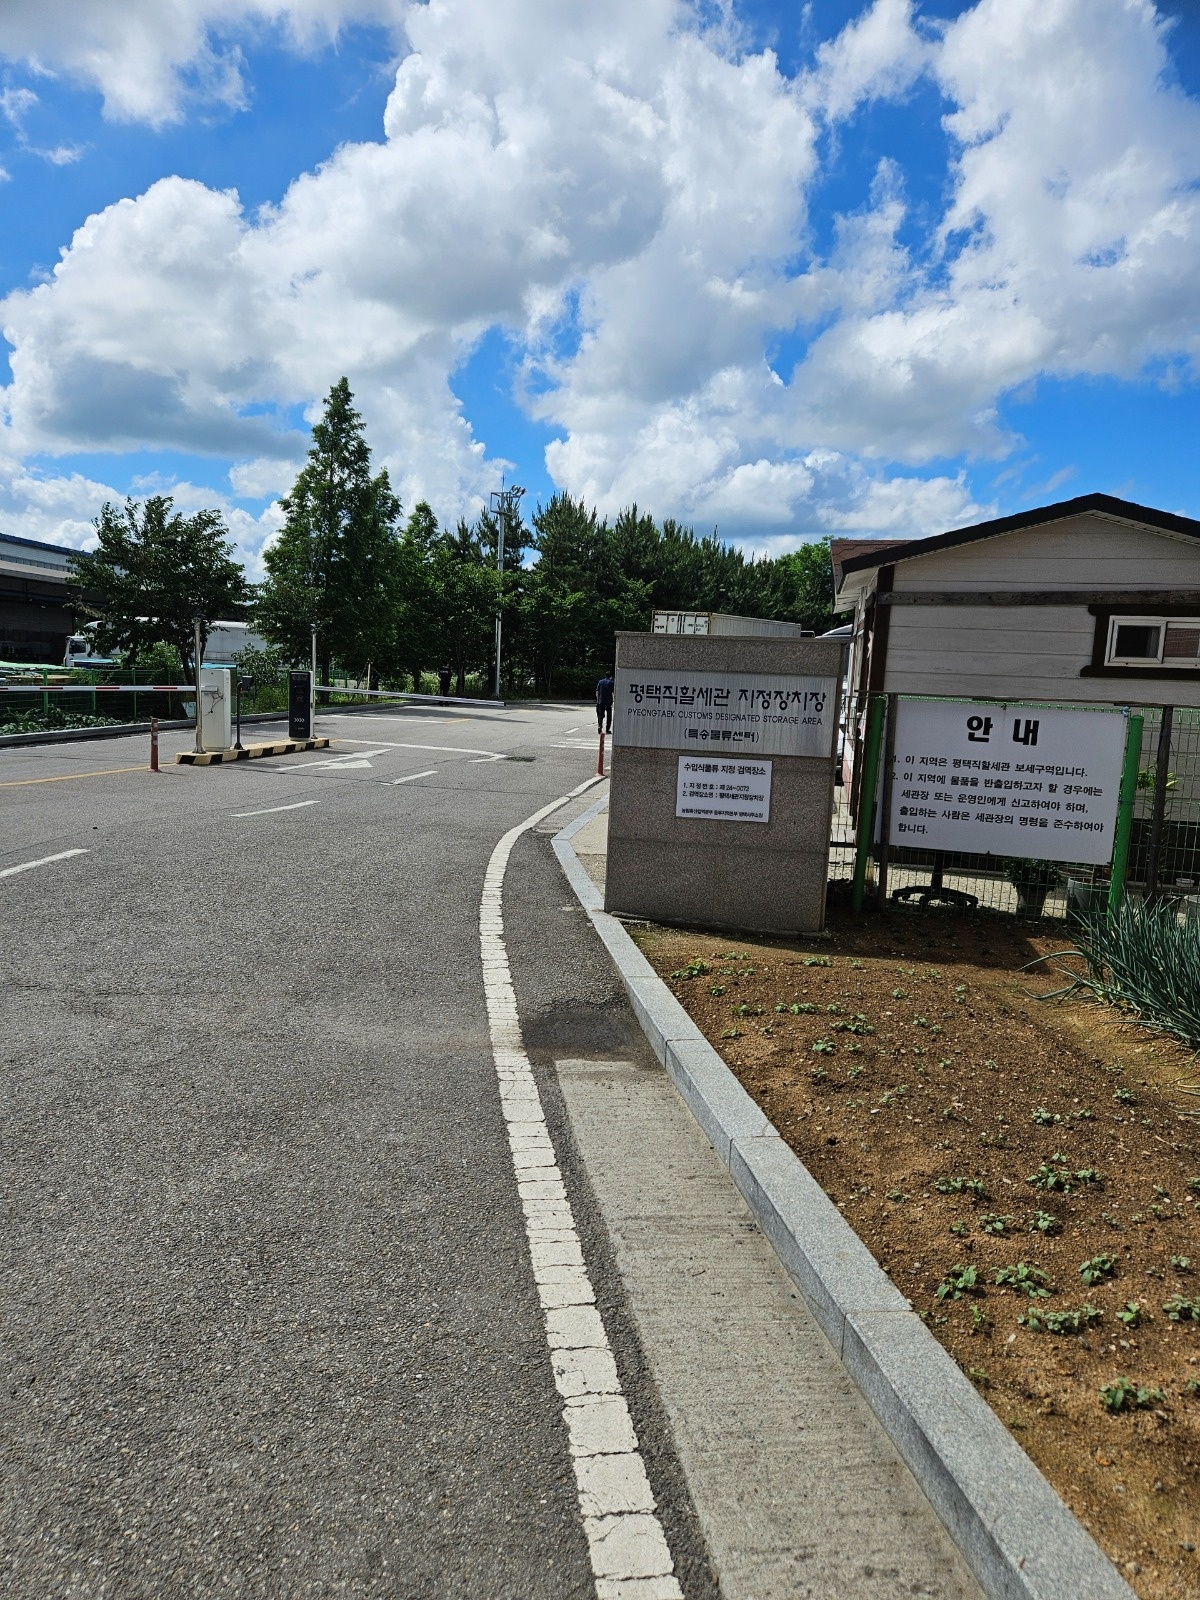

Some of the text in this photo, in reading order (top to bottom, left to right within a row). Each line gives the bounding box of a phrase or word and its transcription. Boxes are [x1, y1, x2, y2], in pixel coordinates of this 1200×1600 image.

[629, 683, 826, 712] 평택직할세관 지정장치장
[628, 709, 822, 725] PYEONGTAEK CUSTOMS DESIGNATED STORAGE AREA
[684, 728, 759, 743] (특송물류센터)
[684, 763, 766, 775] 수입식물류 지정 검역장소
[905, 756, 914, 765] 이
[919, 756, 947, 767] 지역은
[953, 758, 1010, 772] 평택직할세관
[1015, 763, 1088, 777] 보세구역입니다.
[903, 772, 912, 782] 이
[917, 773, 946, 785] 지역에
[950, 776, 979, 787] 물품을
[984, 778, 1043, 793] 반출입하고자
[1048, 783, 1058, 793] 할
[1063, 783, 1103, 796] 경우에는
[901, 789, 1088, 814] 세관장 또는 운영인에게 신고하여야 하며,
[898, 823, 928, 834] 합니다.
[900, 806, 1104, 833] 출입하는 사람은 세관장의 명령을 준수하여야
